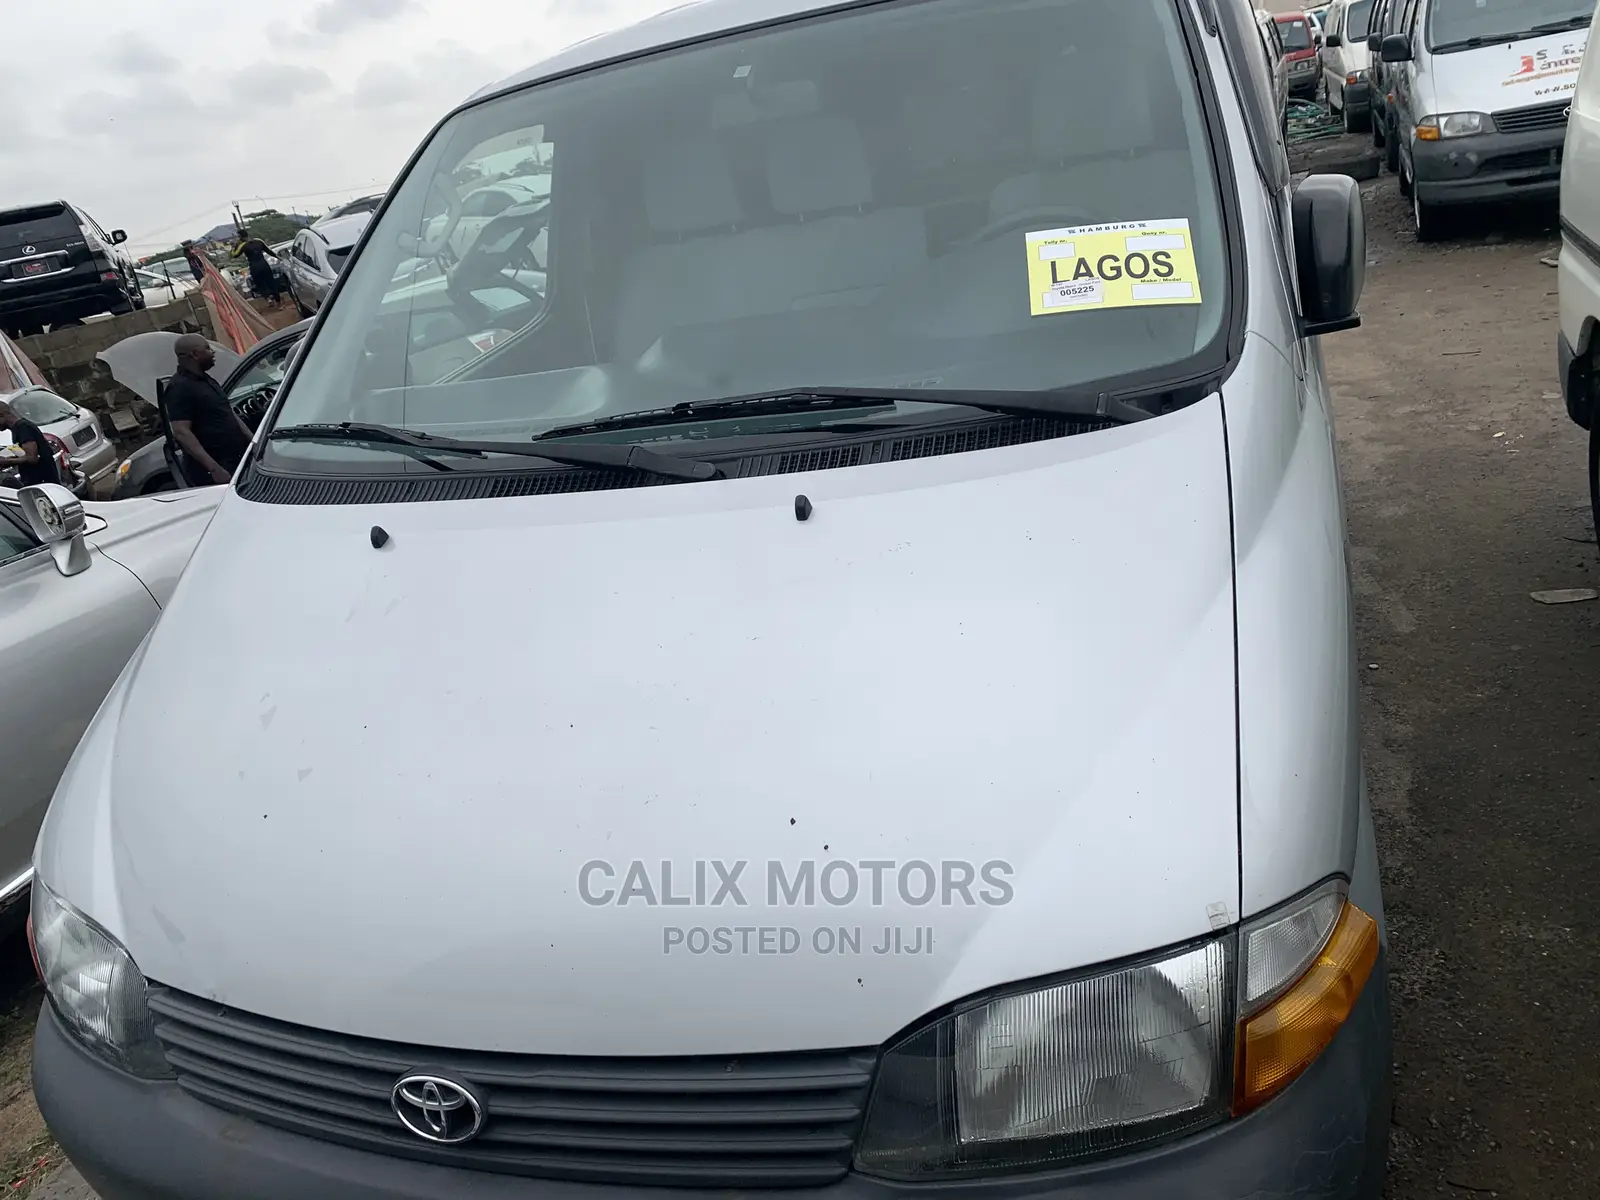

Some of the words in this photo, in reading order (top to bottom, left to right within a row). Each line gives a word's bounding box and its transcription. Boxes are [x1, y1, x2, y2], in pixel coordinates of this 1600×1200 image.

[1079, 223, 1136, 233] HAMBURG
[1050, 251, 1174, 284] LAGOS
[1060, 285, 1095, 296] 005225
